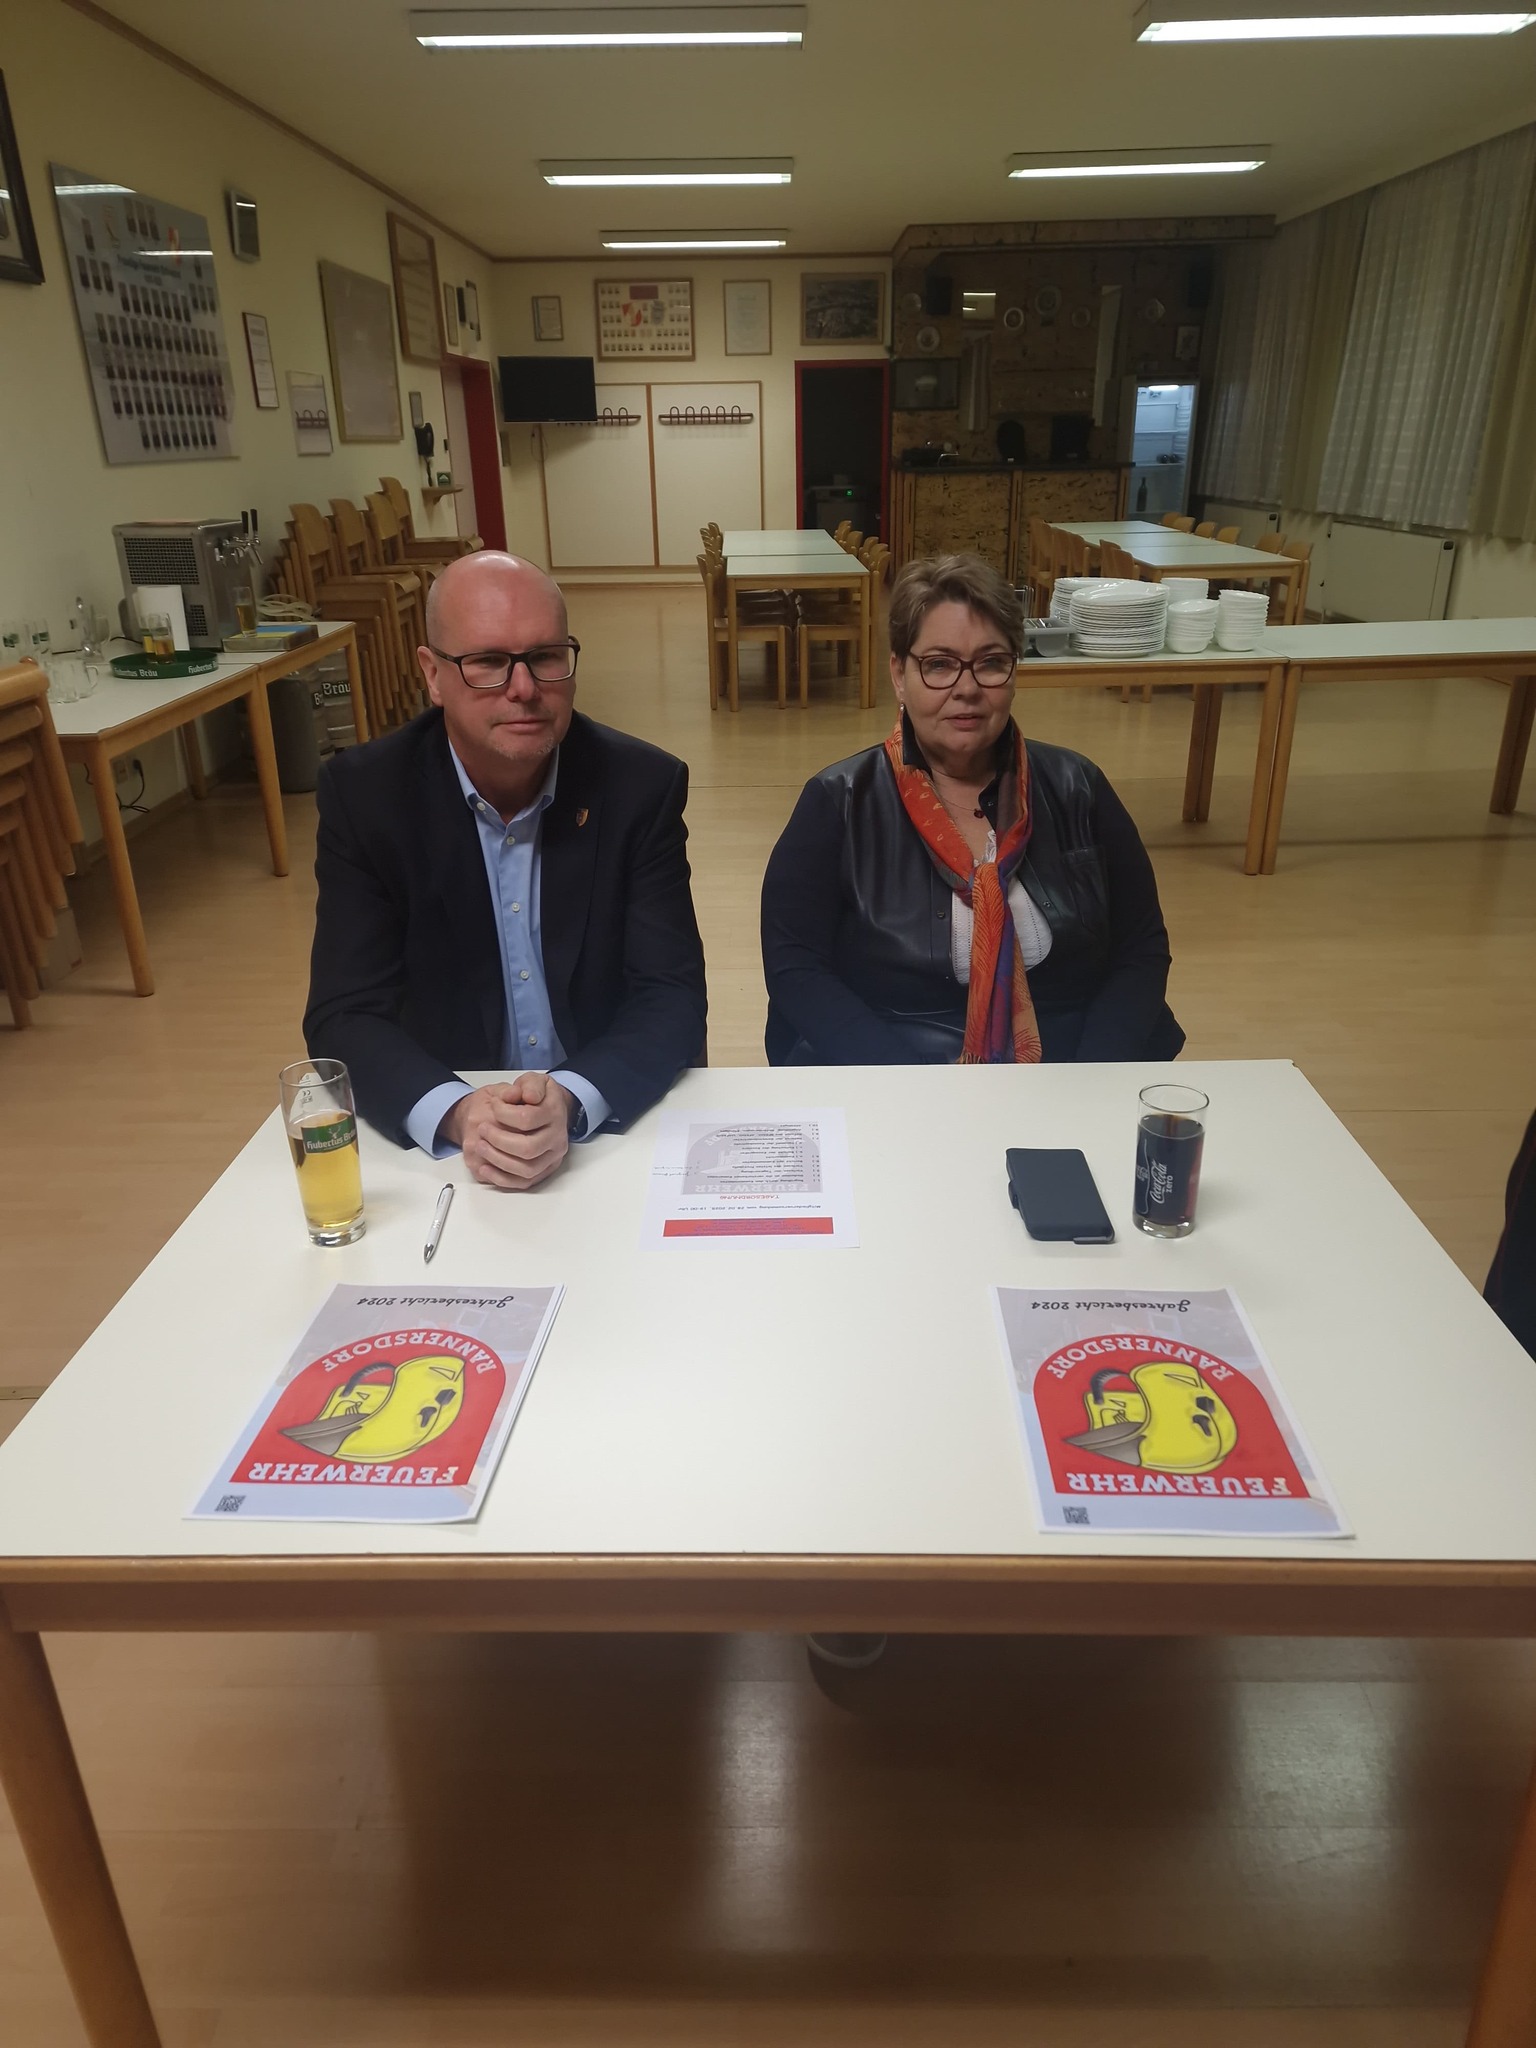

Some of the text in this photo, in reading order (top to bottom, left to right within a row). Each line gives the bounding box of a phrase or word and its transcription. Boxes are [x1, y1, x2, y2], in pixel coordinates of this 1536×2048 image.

[307, 1136, 343, 1149] Hubertus
[695, 1183, 809, 1193] FEUERWEHR
[1165, 1175, 1173, 1194] zero
[357, 1295, 515, 1308] Jahresbericht 2024
[1031, 1299, 1191, 1312] Jahresbericht 2024
[321, 1331, 497, 1375] RANNERSDORF
[1047, 1337, 1235, 1382] RANNERSDORF
[248, 1462, 459, 1486] FEUERWEHR
[1066, 1472, 1293, 1496] FEUERWEHR
